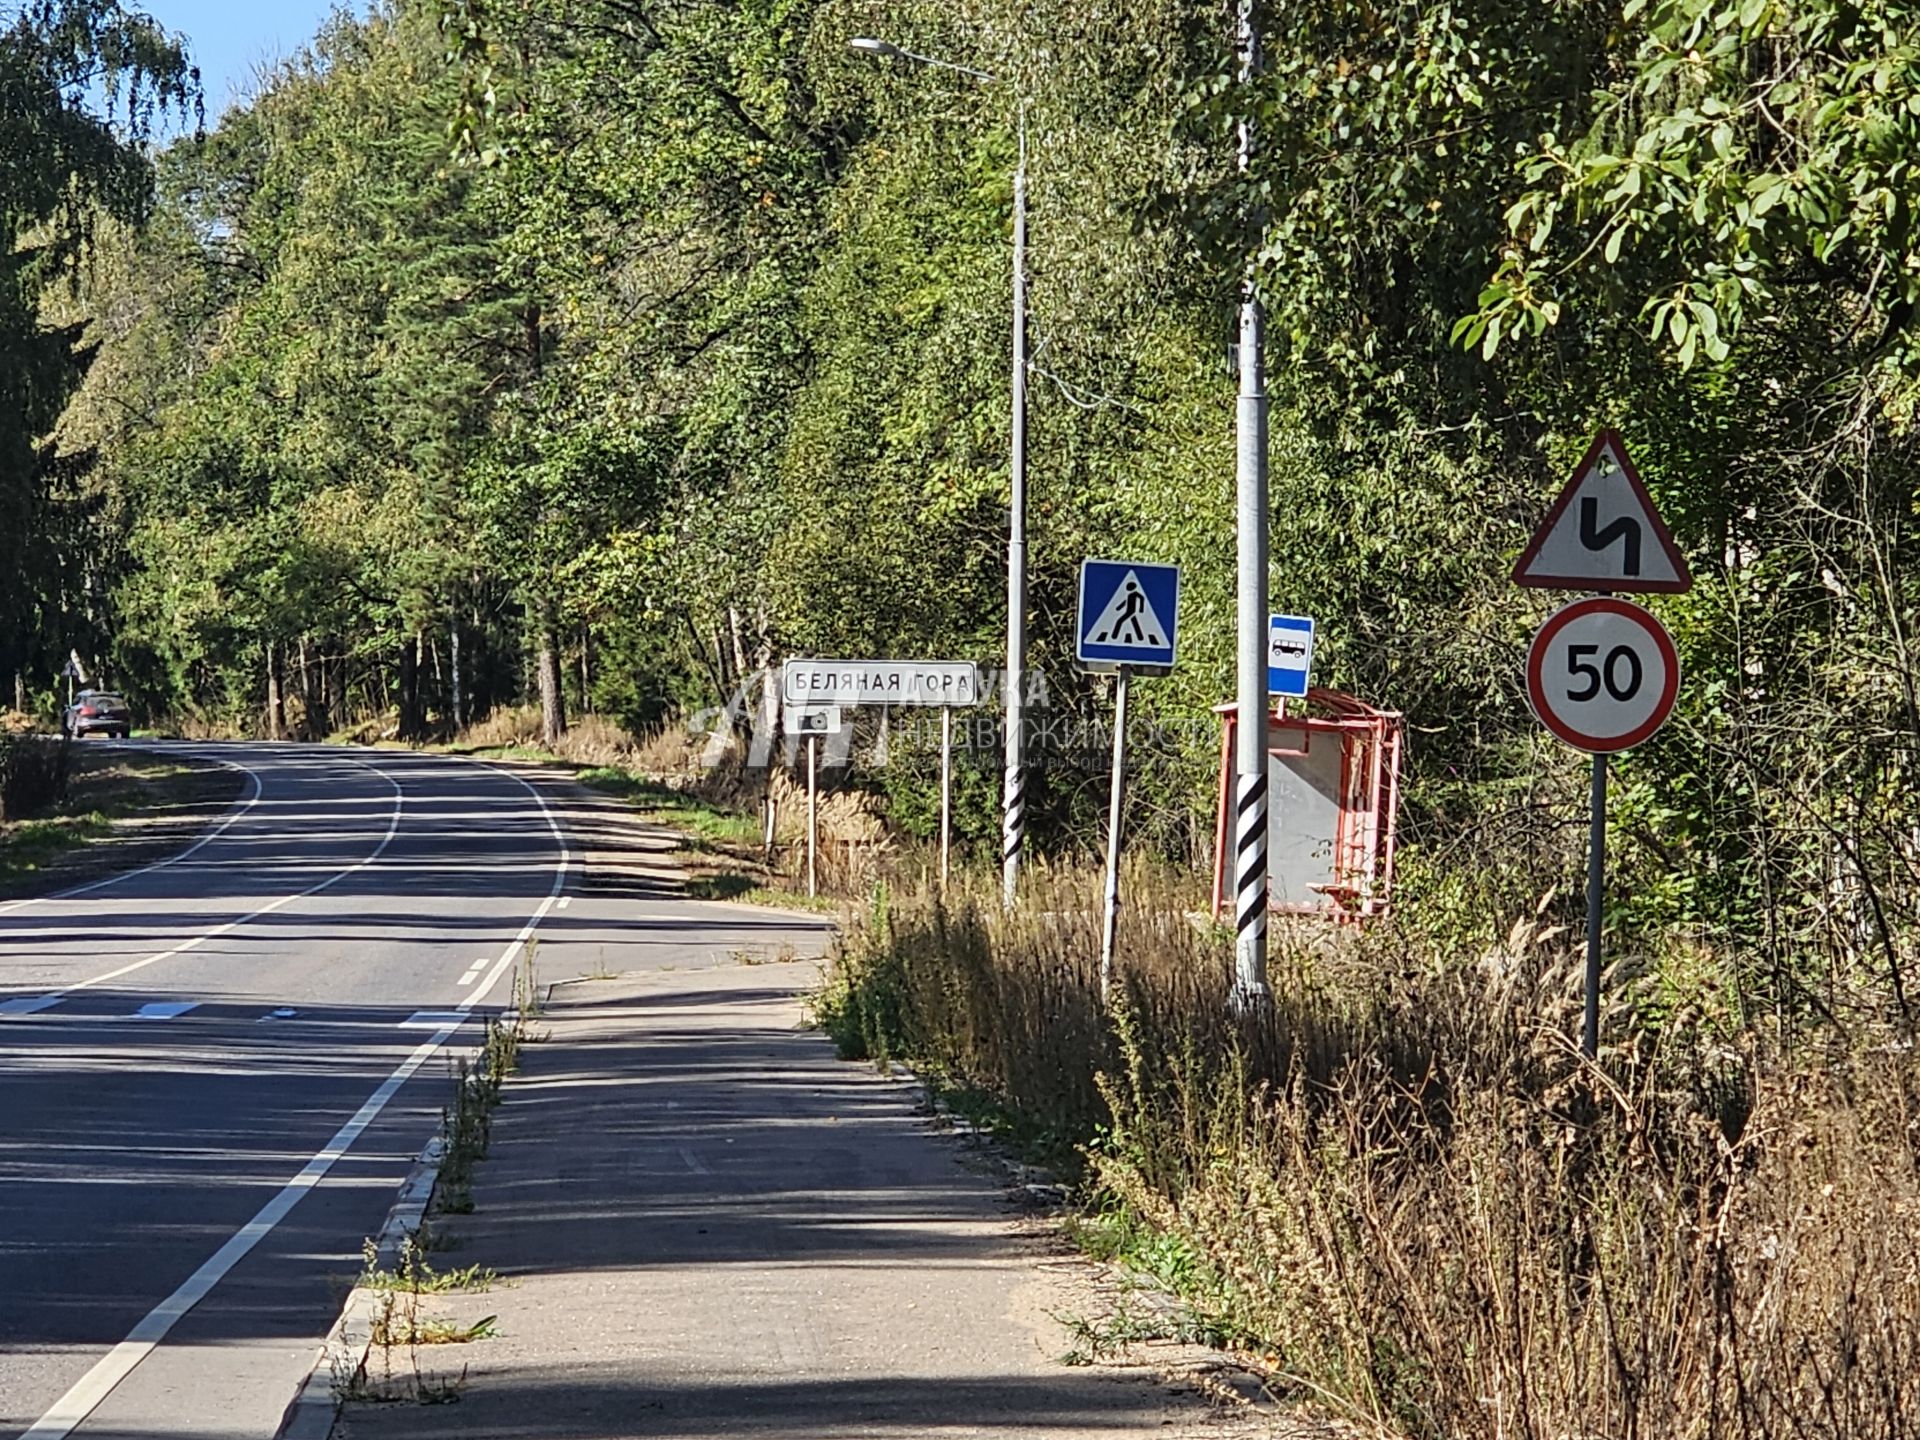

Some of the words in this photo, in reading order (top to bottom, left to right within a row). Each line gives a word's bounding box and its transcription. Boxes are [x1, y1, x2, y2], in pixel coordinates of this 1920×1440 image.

[795, 672, 900, 691] БЕЛЯНАЯ
[913, 674, 970, 693] ГОРА
[1567, 645, 1643, 702] 50
